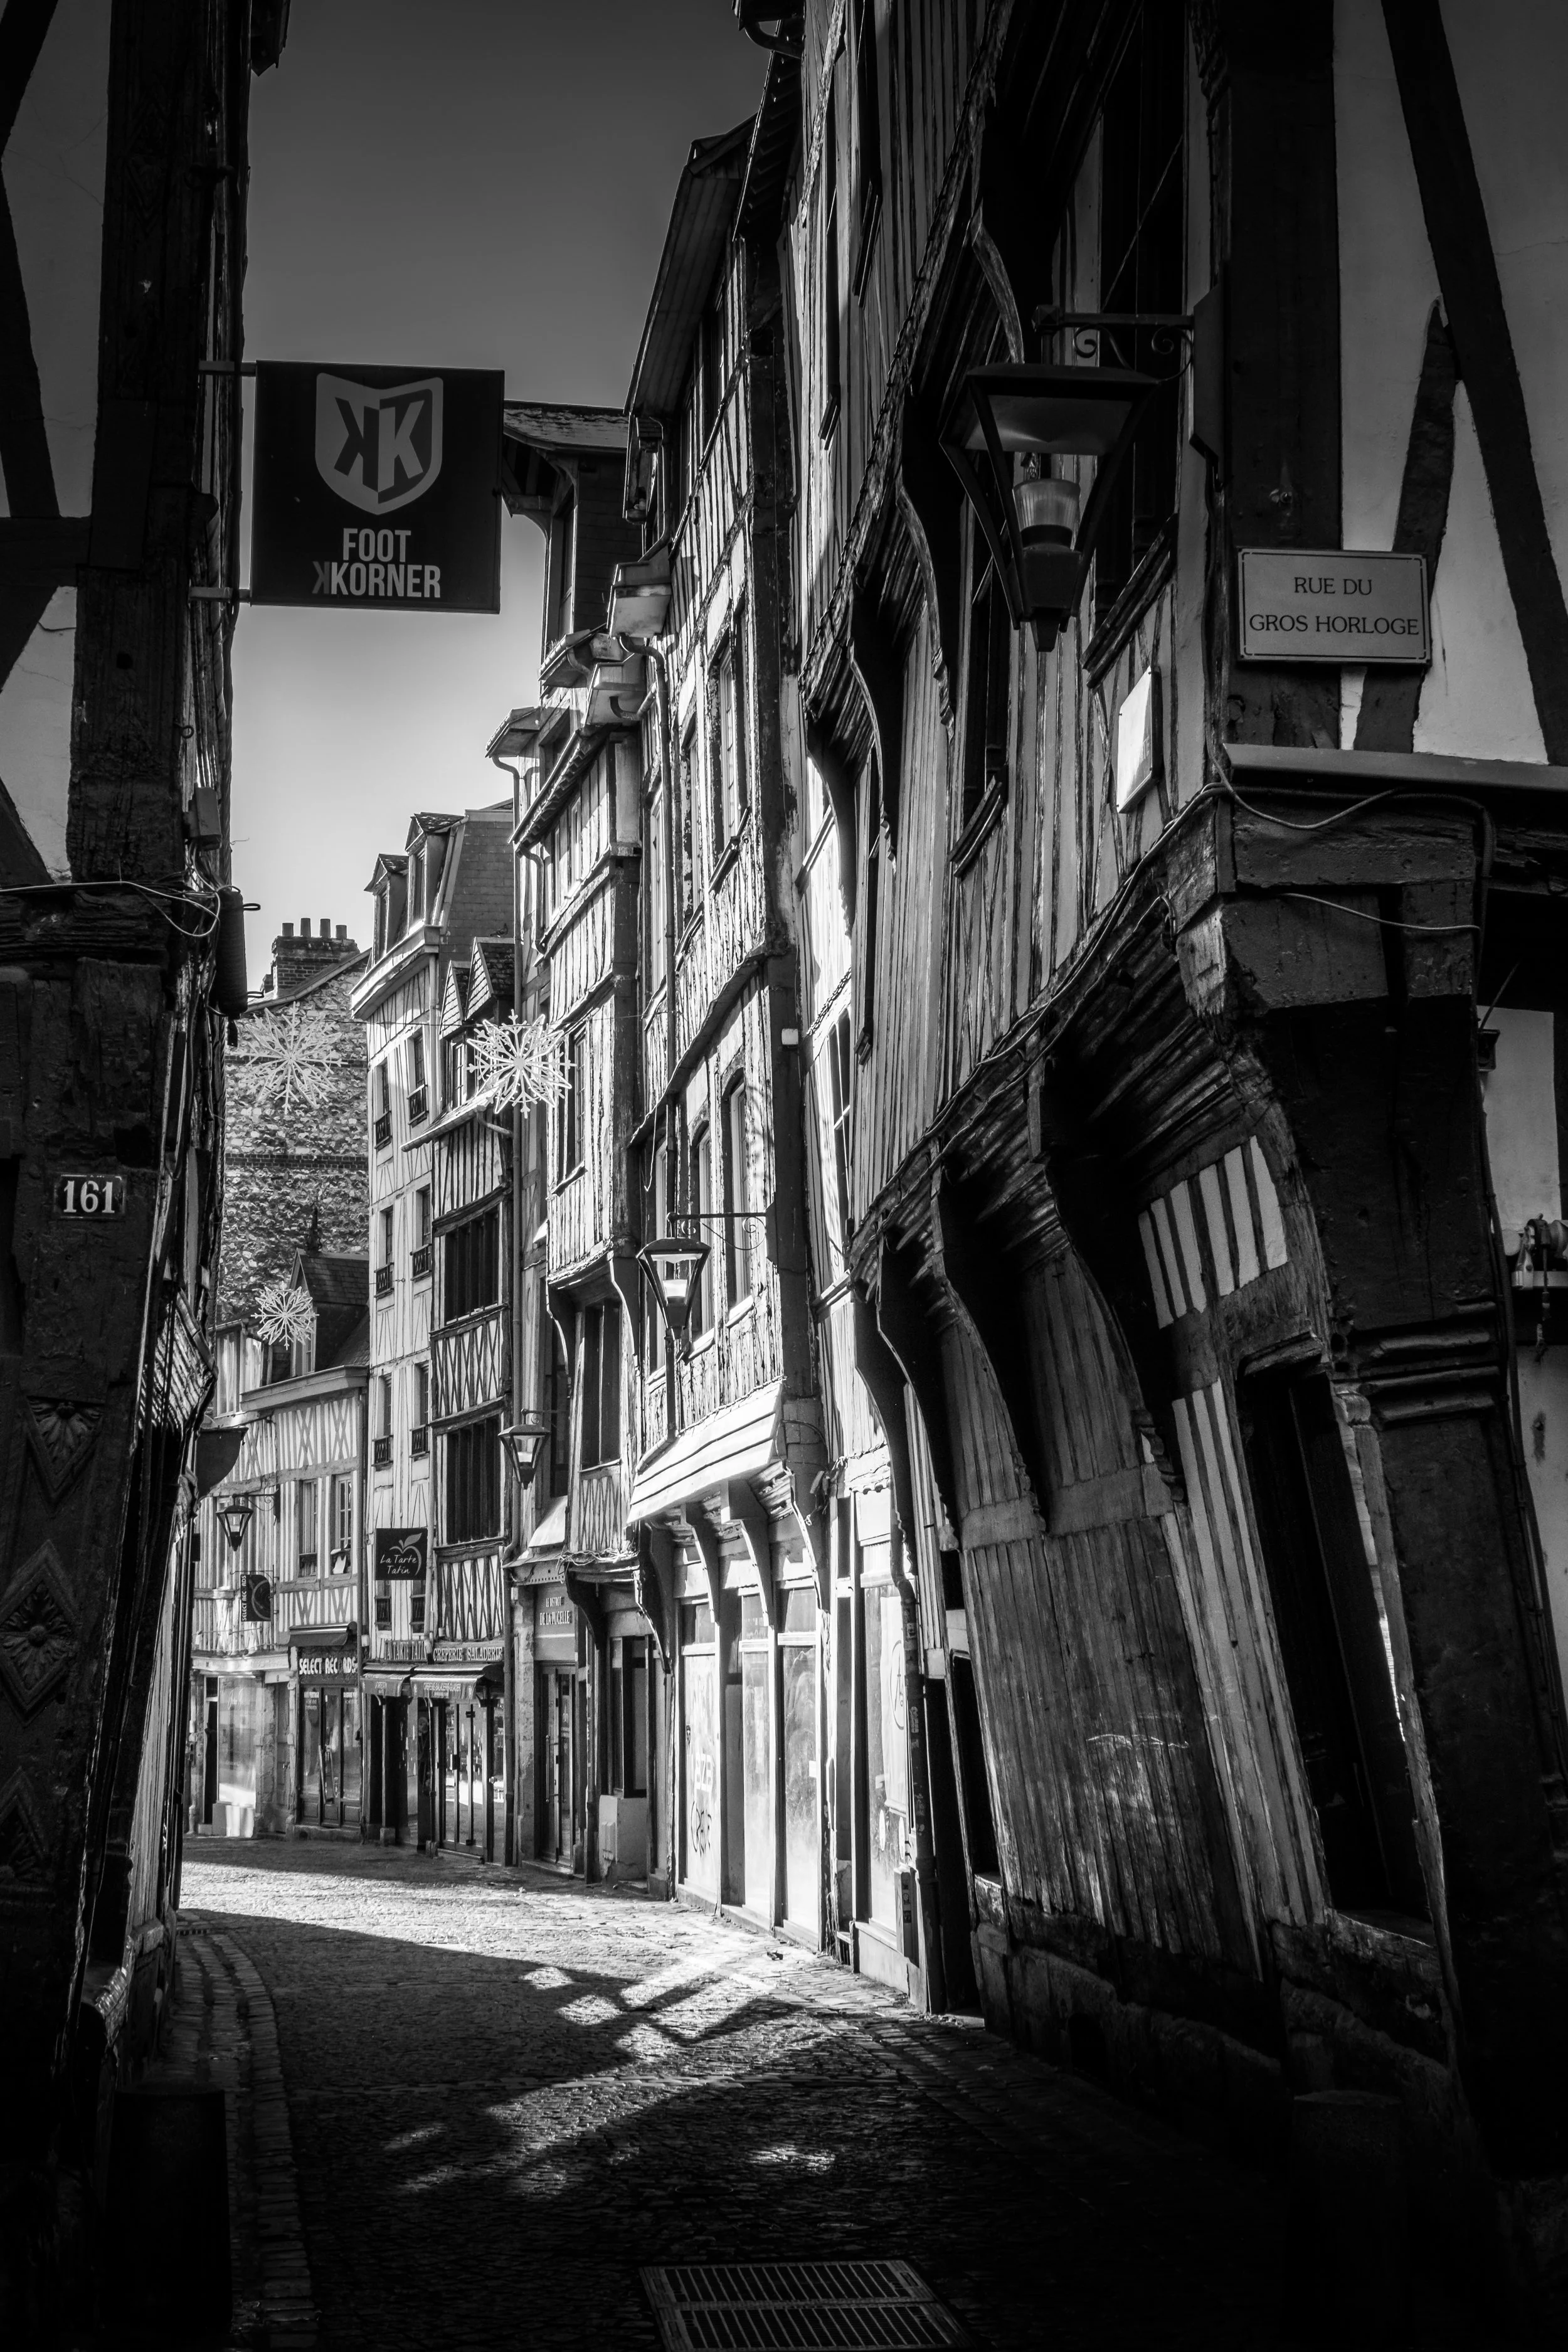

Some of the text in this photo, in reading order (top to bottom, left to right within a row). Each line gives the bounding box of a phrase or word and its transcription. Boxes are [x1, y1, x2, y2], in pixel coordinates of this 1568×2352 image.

[343, 527, 411, 563] FOOT
[1294, 577, 1372, 595] RUE DU
[1249, 614, 1419, 635] GROS HORLOGE
[63, 1180, 115, 1213] 161
[380, 1554, 417, 1564] La Tarte
[387, 1565, 411, 1574] Tatin
[433, 1646, 503, 1661] CREPERIE SALADERIE
[299, 1658, 322, 1675] SELECT
